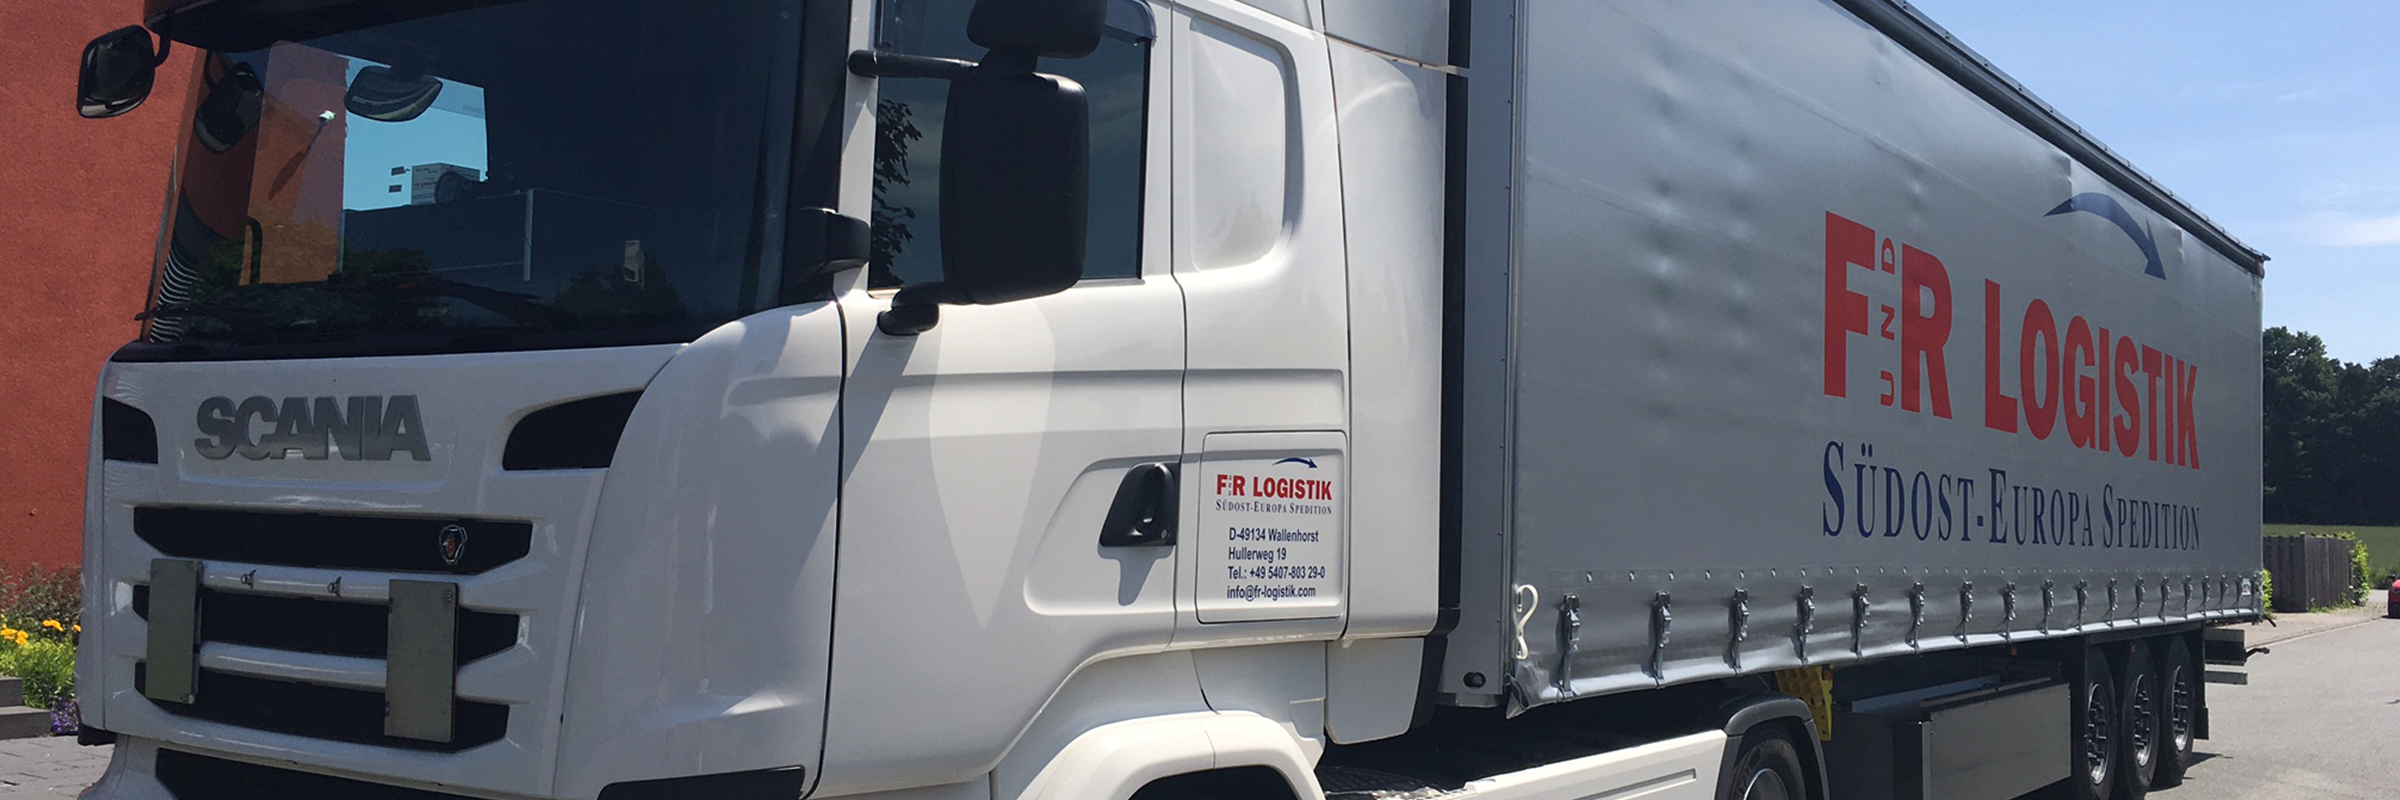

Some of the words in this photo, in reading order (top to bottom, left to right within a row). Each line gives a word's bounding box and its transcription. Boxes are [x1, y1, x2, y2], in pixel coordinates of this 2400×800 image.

[1985, 278, 2200, 470] LOGISTIK
[195, 395, 431, 461] SCANIA
[1253, 476, 1332, 500] LOGISTIK
[2103, 484, 2200, 551] SPEDITION
[1229, 527, 1266, 542] D-49134
[1268, 528, 1319, 542] Wallenhorst
[1228, 547, 1274, 563] Hullerweg
[1277, 547, 1287, 560] 19
[1228, 566, 1247, 579] Tel.:
[1249, 566, 1266, 579] +49
[1267, 566, 1306, 579] 5407-803
[1308, 566, 1326, 579] 29-0
[1227, 585, 1316, 601] info@fr-logistik.com
